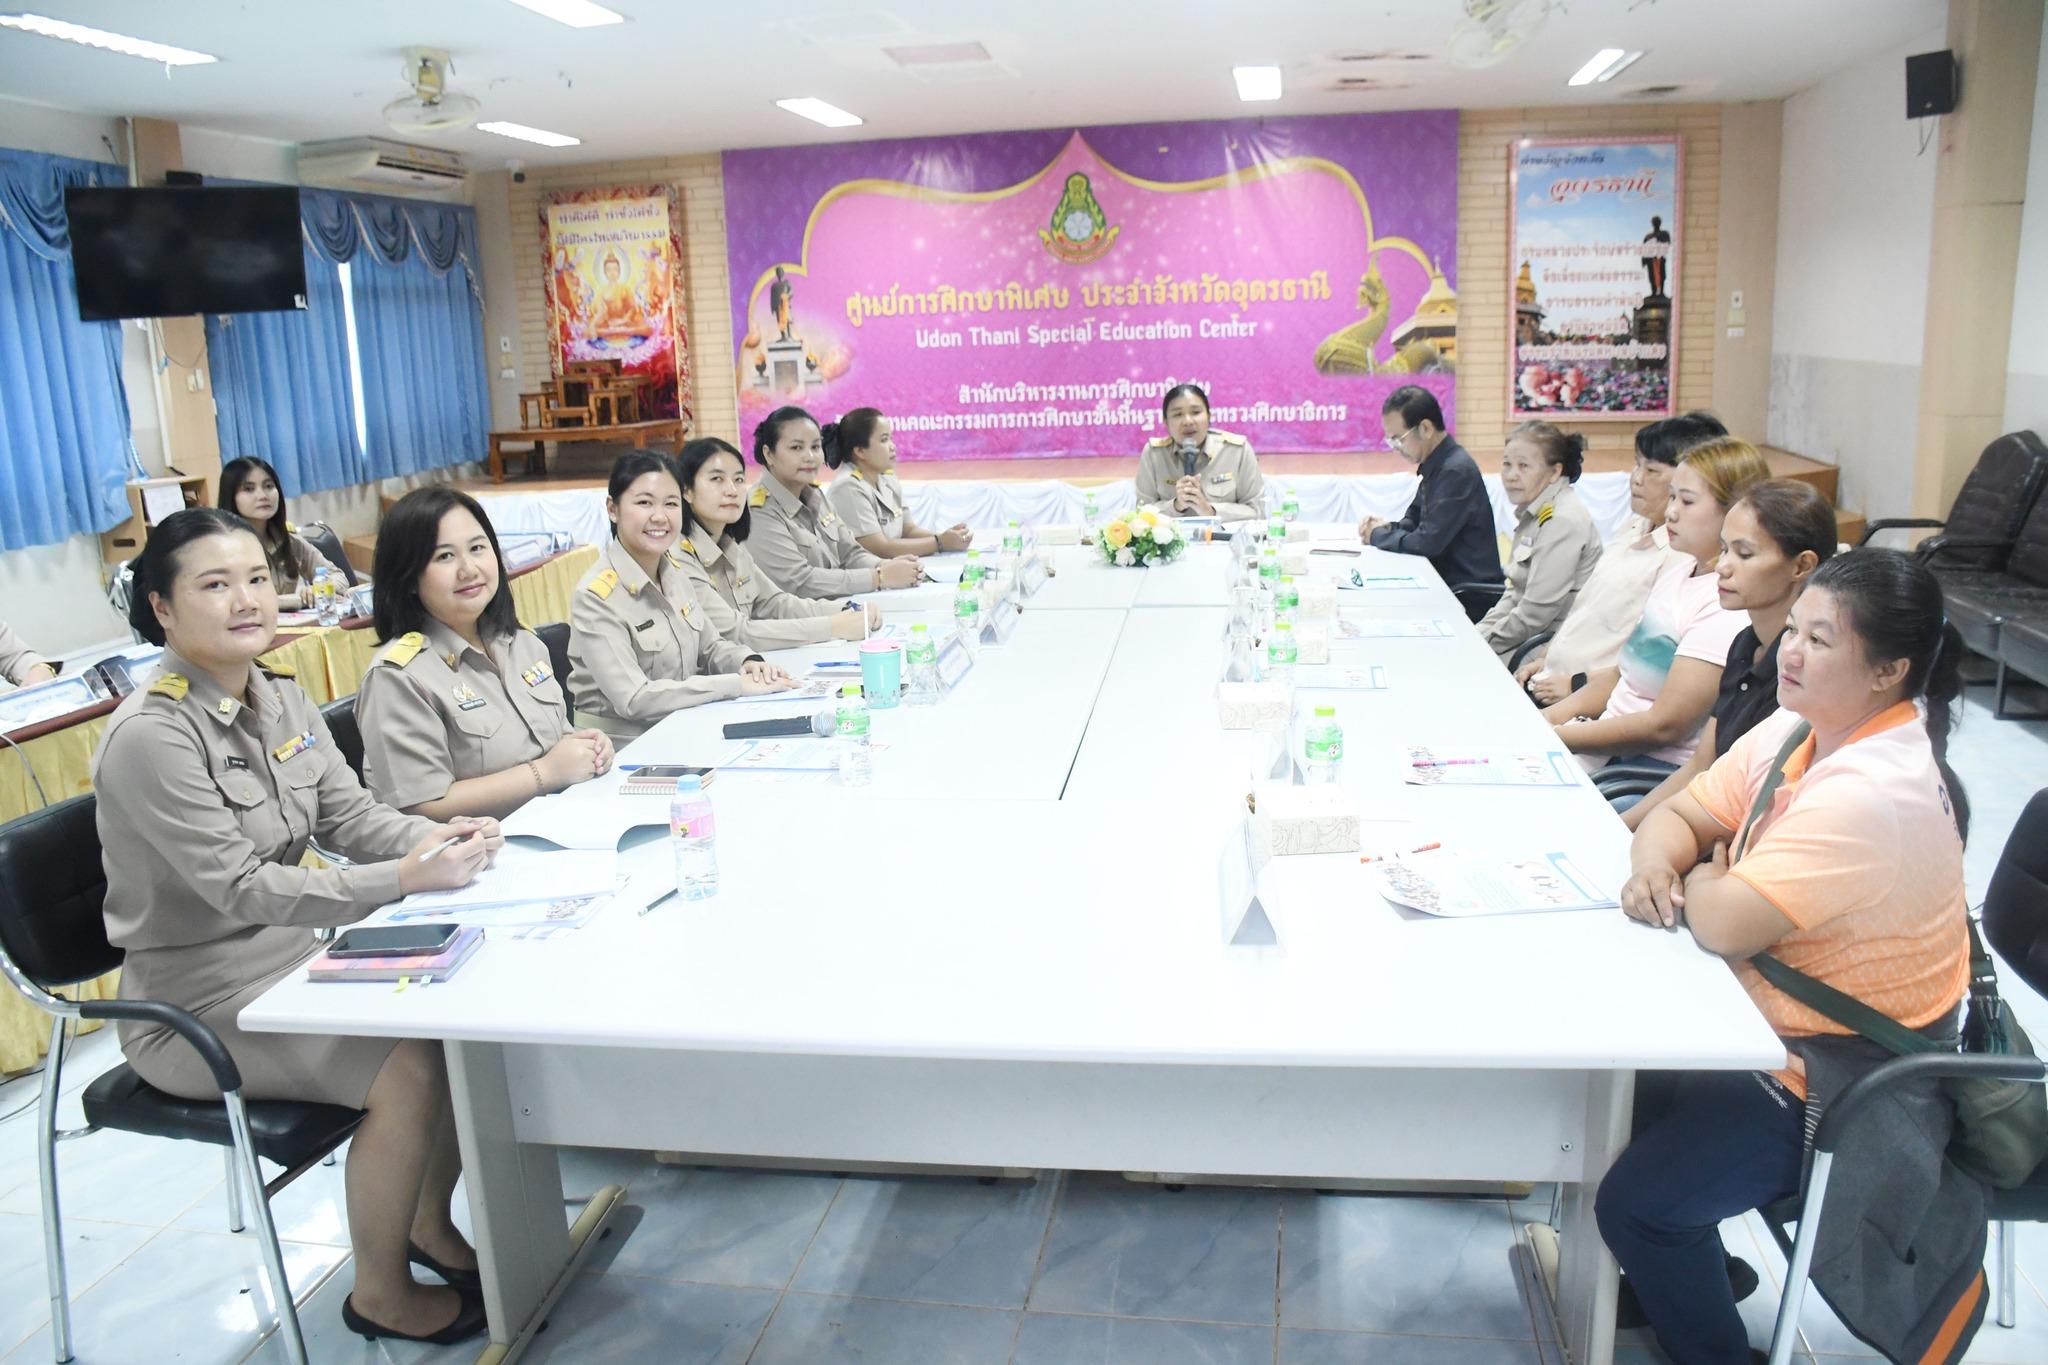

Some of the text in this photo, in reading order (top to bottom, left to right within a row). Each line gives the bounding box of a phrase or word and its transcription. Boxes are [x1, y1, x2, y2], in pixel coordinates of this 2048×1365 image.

[1550, 166, 1658, 202] อุดรธานี
[846, 270, 1332, 327] ศูนย์การศึกษาพิเศษ ประจำจังหวัดอุดรธานี
[915, 315, 1258, 348] Udon Thani Special Education Center
[958, 378, 1211, 404] สำนักบริหารงานการศึกษาิษ
[1208, 400, 1347, 423] ะทรวงศึกษาธิการ
